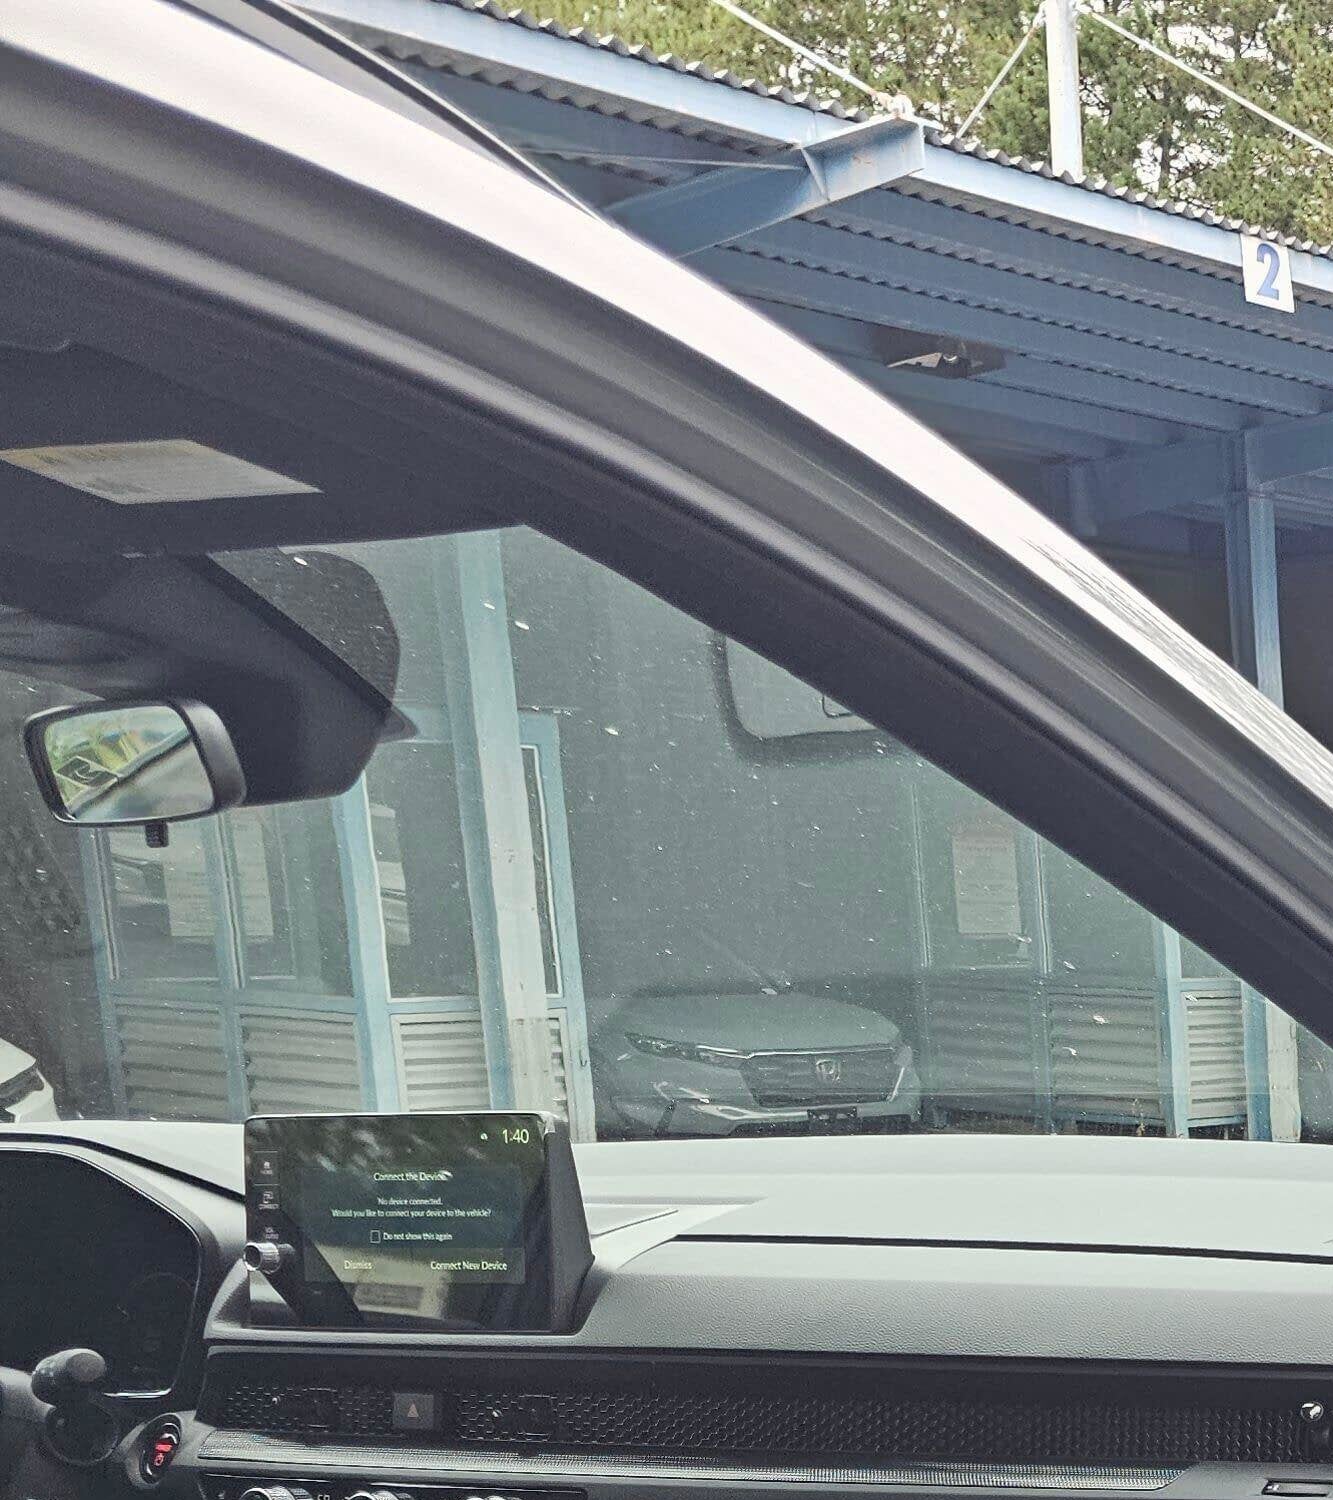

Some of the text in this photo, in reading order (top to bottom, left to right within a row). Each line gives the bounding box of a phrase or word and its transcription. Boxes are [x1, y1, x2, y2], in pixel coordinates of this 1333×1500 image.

[1257, 243, 1280, 301] 2
[503, 1129, 530, 1144] 1:40
[374, 1172, 404, 1181] Connect
[405, 1172, 418, 1181] the
[353, 1210, 365, 1218] you
[344, 1260, 508, 1271] Dismiss Connect New Device
